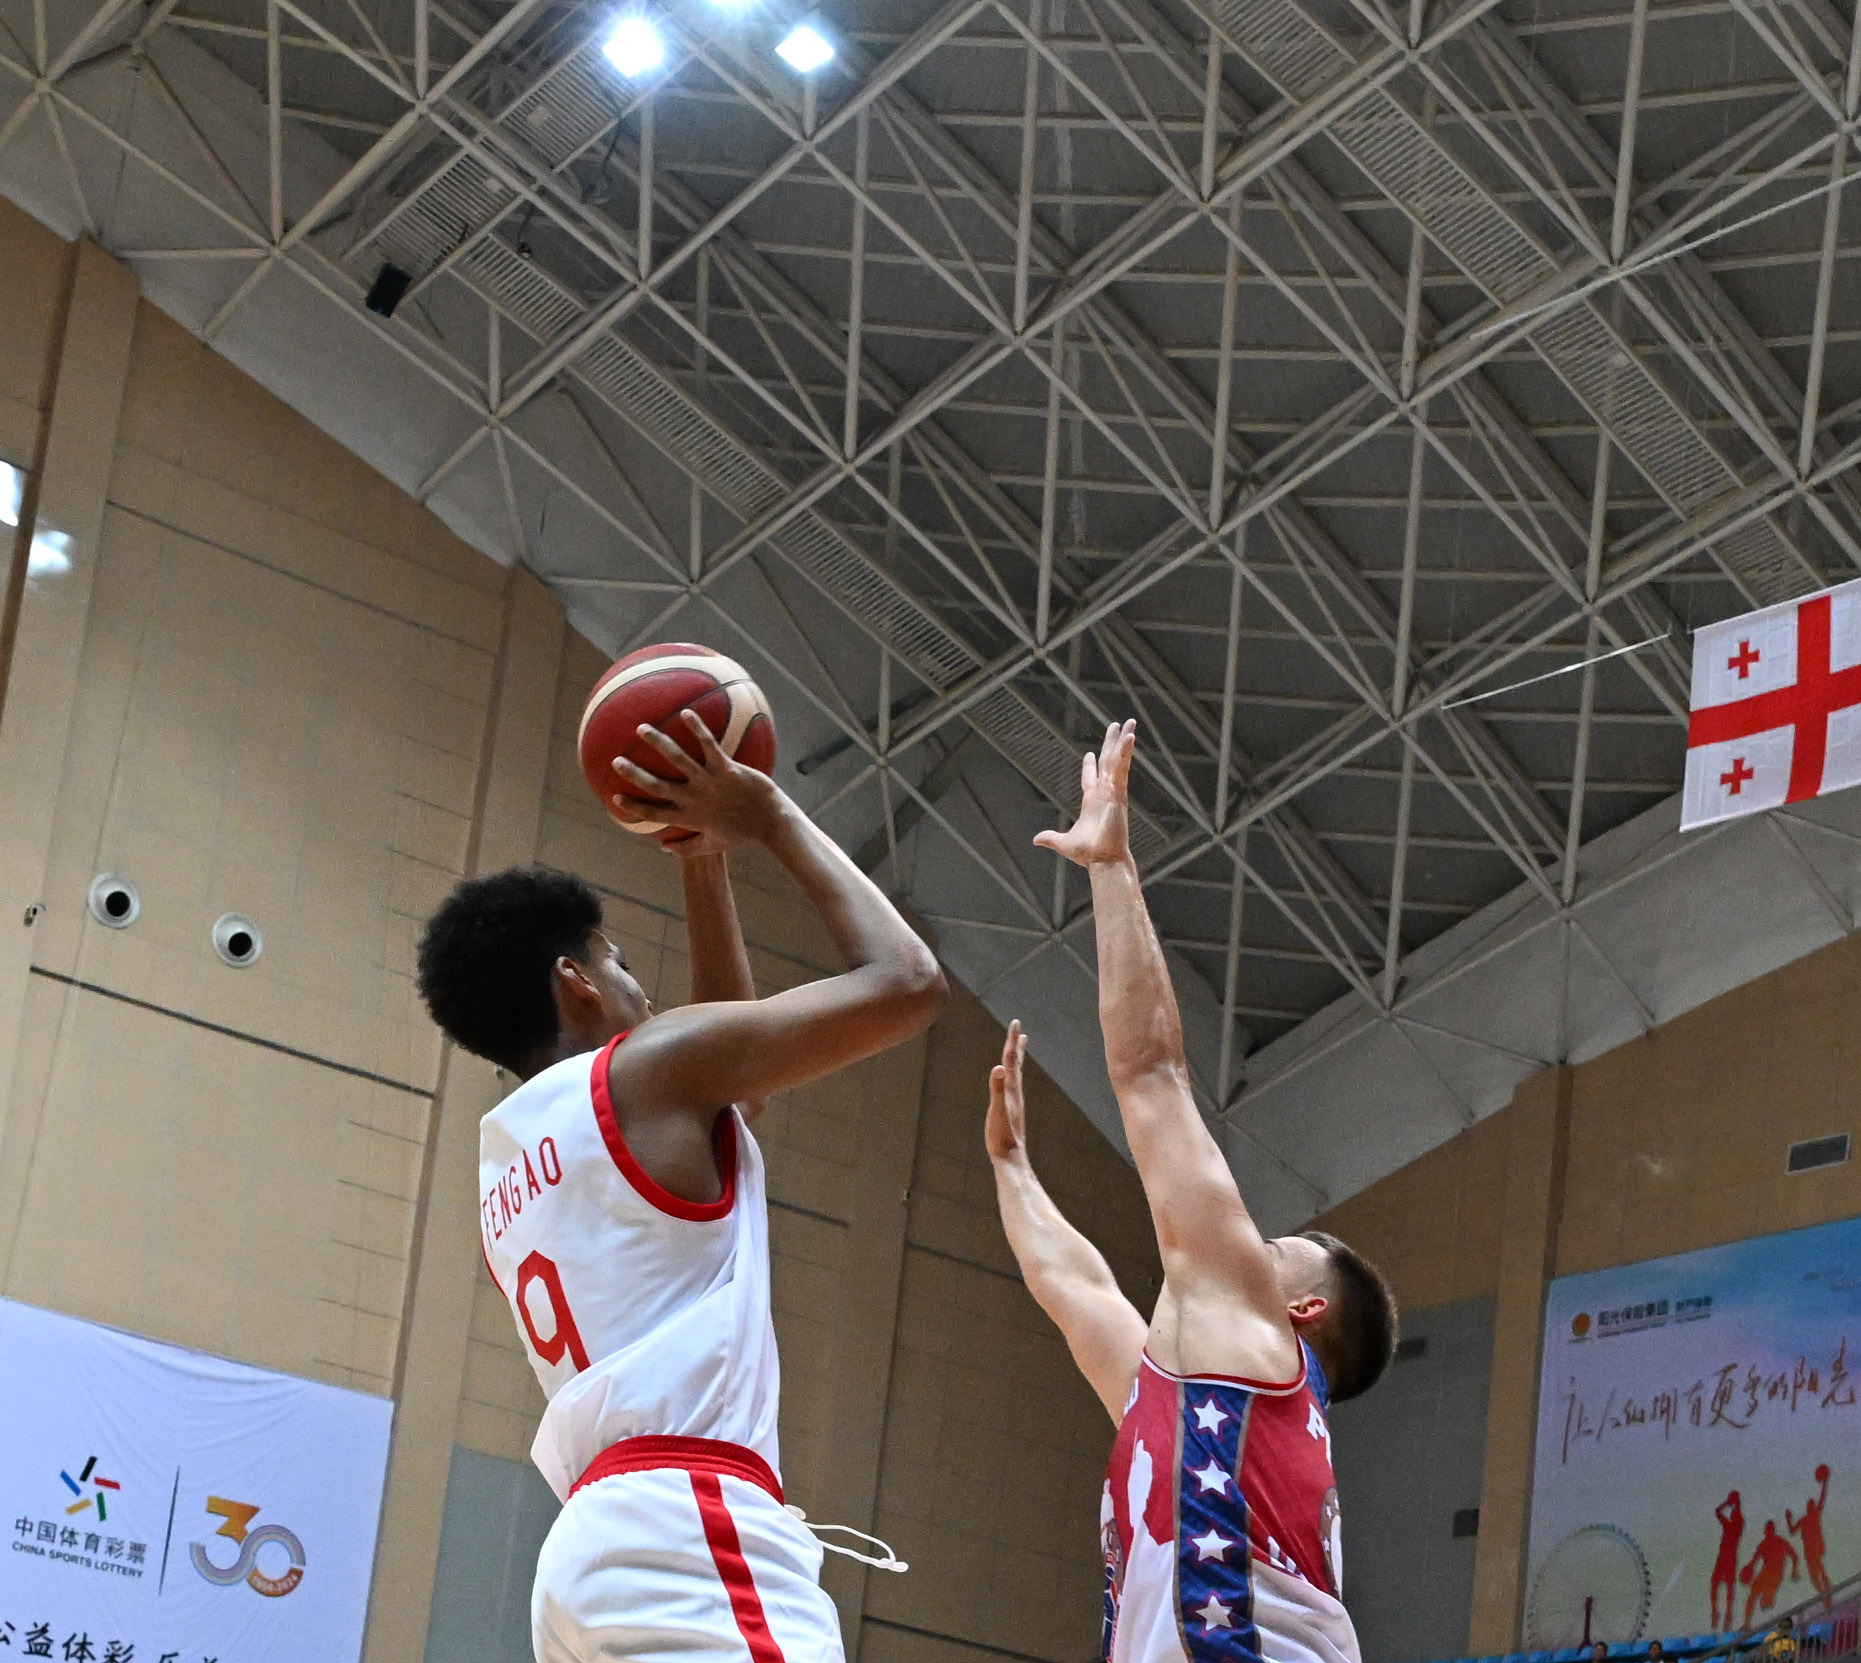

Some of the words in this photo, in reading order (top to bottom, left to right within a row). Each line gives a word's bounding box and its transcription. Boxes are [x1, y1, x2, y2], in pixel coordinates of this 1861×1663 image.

[516, 1250, 591, 1373] 9
[12, 1541, 46, 1557] CHINA
[48, 1549, 93, 1568] SPORTS
[94, 1560, 144, 1578] LOTTERY
[14, 1515, 147, 1565] 中国体育彩票
